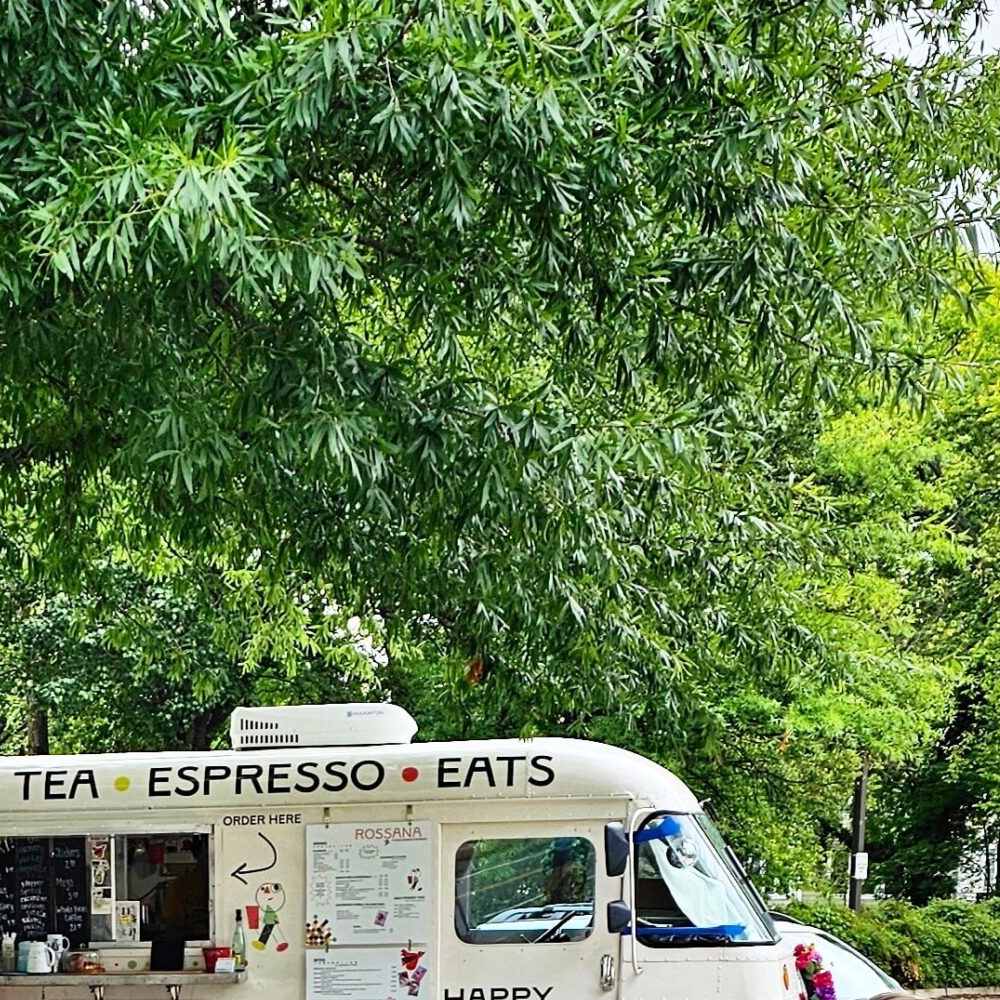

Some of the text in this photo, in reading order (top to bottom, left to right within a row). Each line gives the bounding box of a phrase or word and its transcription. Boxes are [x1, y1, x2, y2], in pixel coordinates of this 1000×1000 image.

[14, 769, 99, 801] TEA
[148, 761, 385, 797] ESPRESSO
[437, 755, 555, 789] EATS
[223, 813, 302, 827] ORDER HERE
[355, 826, 423, 841] ROSSANA
